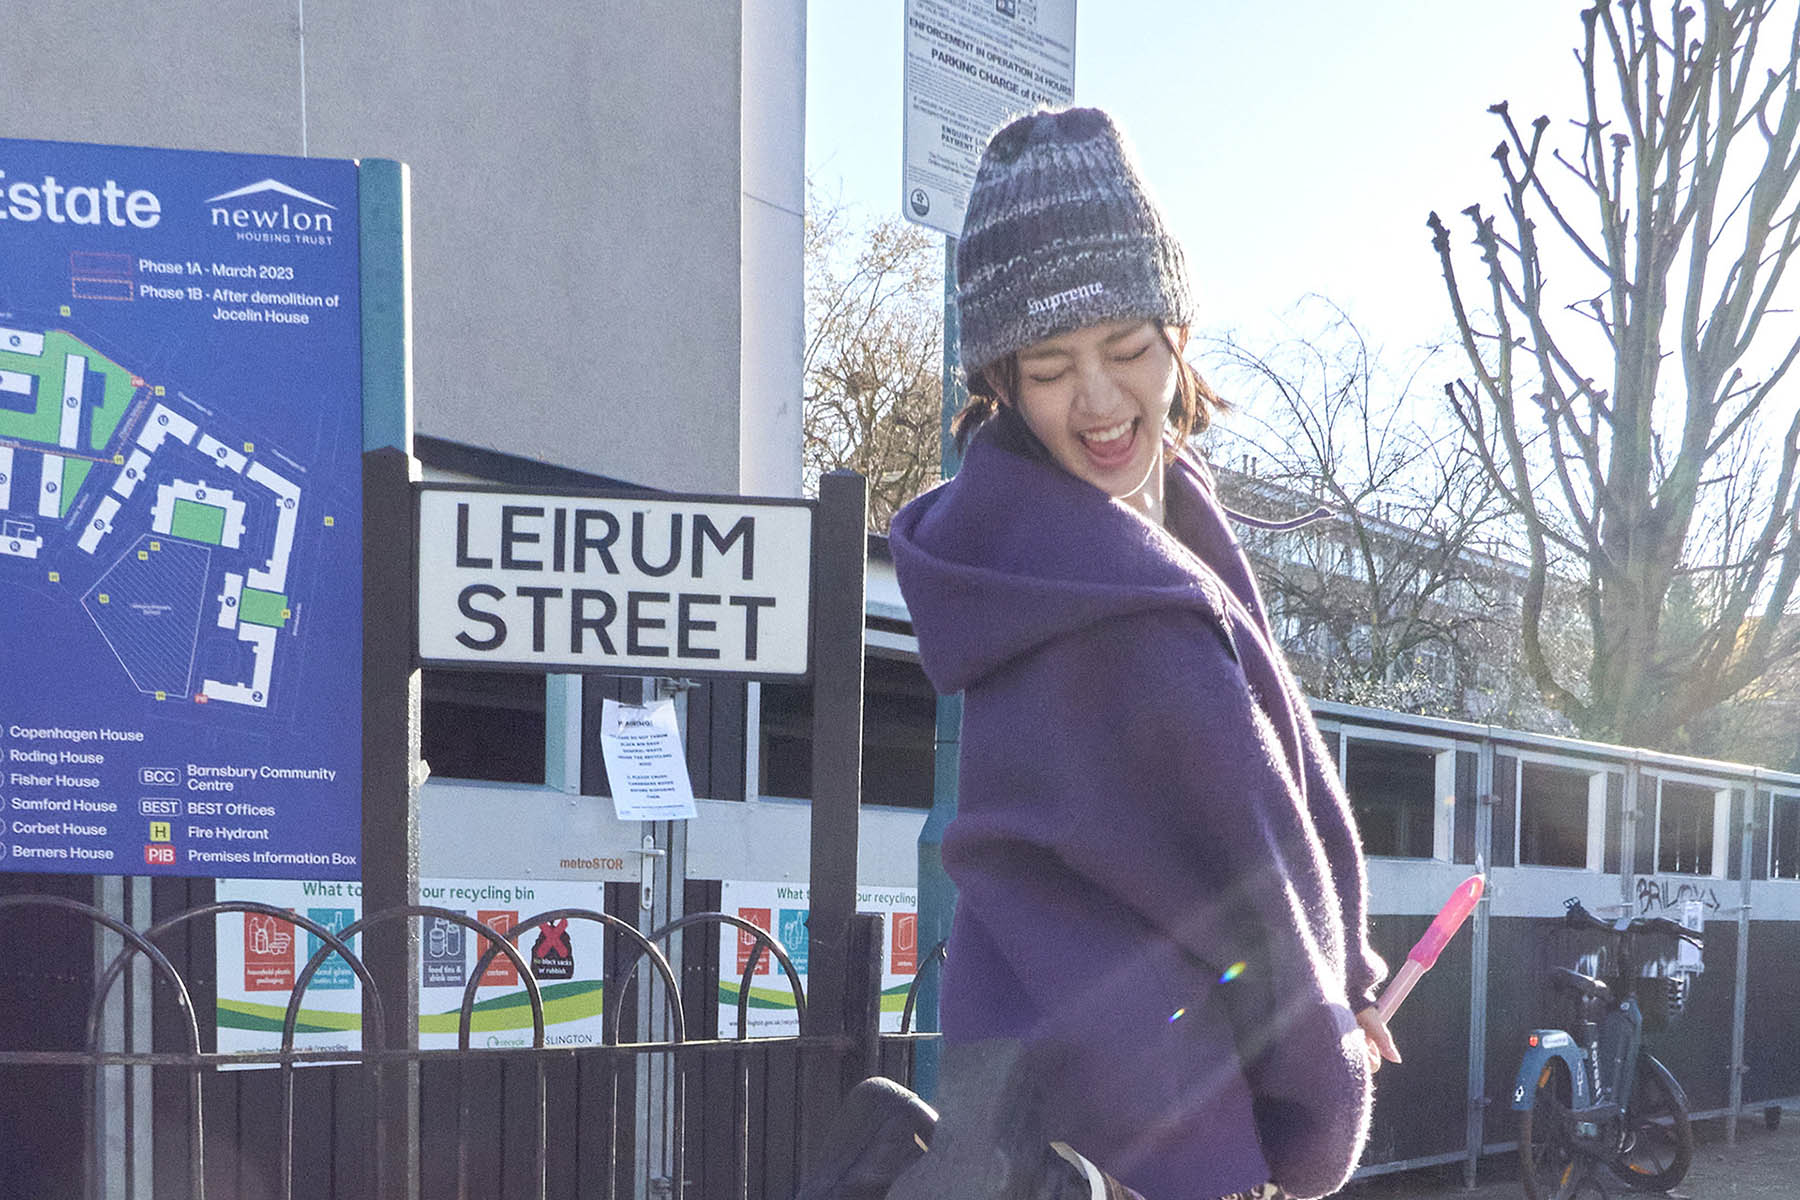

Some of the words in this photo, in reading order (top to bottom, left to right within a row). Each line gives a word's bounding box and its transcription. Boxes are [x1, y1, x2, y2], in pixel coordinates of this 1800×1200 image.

[910, 18, 974, 52] ENFORCEMENT
[976, 47, 985, 58] IN
[986, 51, 1032, 79] OPERATION
[1034, 73, 1044, 83] 24
[1045, 78, 1072, 96] HOURS
[932, 48, 977, 76] PARKING
[978, 67, 1019, 95] CHARGE
[1021, 88, 1029, 98] of
[211, 204, 333, 232] newlon
[236, 232, 290, 243] HOUSING
[295, 234, 333, 246] TRUST
[139, 259, 184, 275] Phase
[186, 262, 202, 276] 1A
[212, 264, 256, 278] March
[259, 266, 294, 280] 2023
[140, 285, 184, 300] Phase
[186, 287, 202, 300] 1B
[213, 289, 248, 304] After
[251, 292, 322, 307] demolition
[325, 295, 339, 307] of
[212, 308, 262, 322] Jocelin
[265, 310, 309, 324] House
[456, 502, 755, 580] LEIRUM
[455, 584, 776, 661] STREET
[10, 726, 98, 742] Copenhagen
[100, 728, 144, 742] House
[10, 750, 58, 765] Roding
[60, 752, 104, 764] House
[10, 773, 53, 786] Fisher
[56, 776, 100, 788] House
[144, 770, 176, 783] BCC
[188, 765, 258, 780] Barnsbury
[260, 766, 336, 782] Community
[188, 779, 234, 791] Centre
[12, 798, 71, 811] Samford
[74, 800, 118, 812] House
[142, 802, 178, 814] BEST
[188, 803, 223, 814] BEST
[226, 803, 276, 816] Offices
[12, 822, 60, 834] Corbet
[63, 823, 108, 836] House
[188, 826, 214, 838] Fire
[216, 827, 269, 840] Hydrant
[12, 846, 68, 858] Berners
[70, 847, 114, 860] House
[148, 849, 174, 862] PIB
[188, 850, 250, 863] Premises
[253, 852, 330, 864] Information
[332, 854, 356, 864] Box
[560, 858, 624, 870] metroSTOR
[303, 880, 343, 897] What
[420, 887, 446, 898] our
[450, 886, 511, 902] recycling
[515, 886, 534, 900] bin
[777, 888, 804, 900] What
[856, 894, 873, 903] our
[874, 893, 916, 907] recycling
[546, 1034, 592, 1045] SLINGTON
